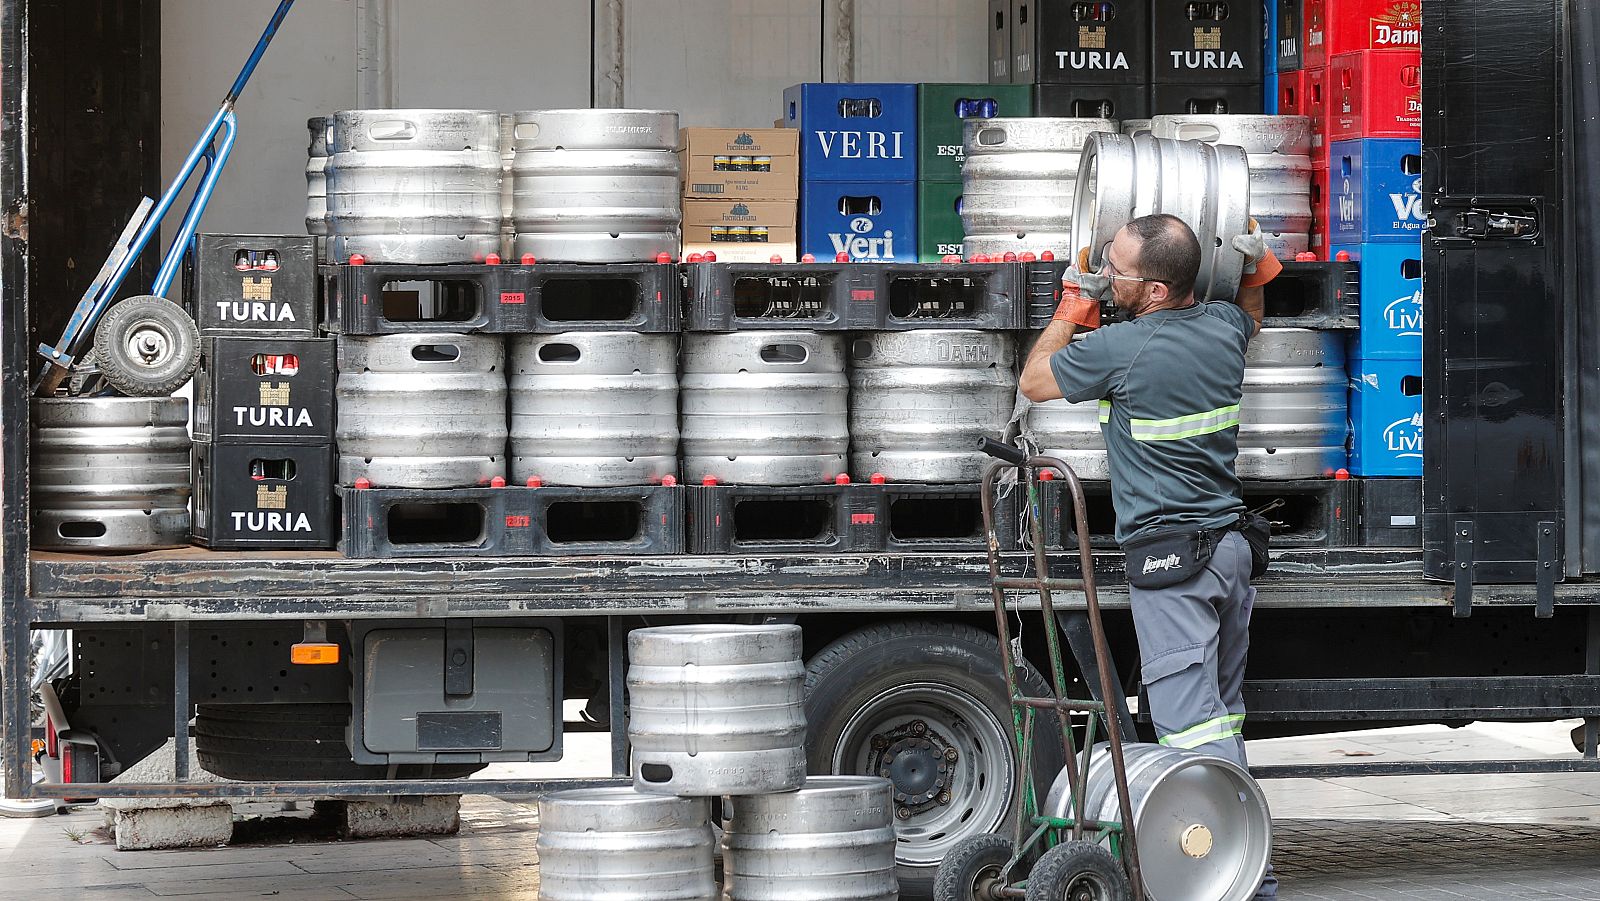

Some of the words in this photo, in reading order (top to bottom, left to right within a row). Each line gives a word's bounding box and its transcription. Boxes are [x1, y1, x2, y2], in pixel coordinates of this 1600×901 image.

[1374, 24, 1421, 46] Dam
[1280, 37, 1297, 57] TURIA
[1055, 51, 1130, 70] TURIA
[1170, 51, 1244, 69] TURIA
[815, 131, 904, 159] VERI
[1339, 192, 1354, 222] Veri
[1401, 222, 1421, 230] Agua
[828, 229, 895, 259] Veri
[216, 301, 296, 322] TURIA
[935, 338, 990, 363] DAMM
[233, 406, 314, 427] TURIA
[230, 511, 312, 532] TURIA
[855, 807, 882, 816] GRUPO
